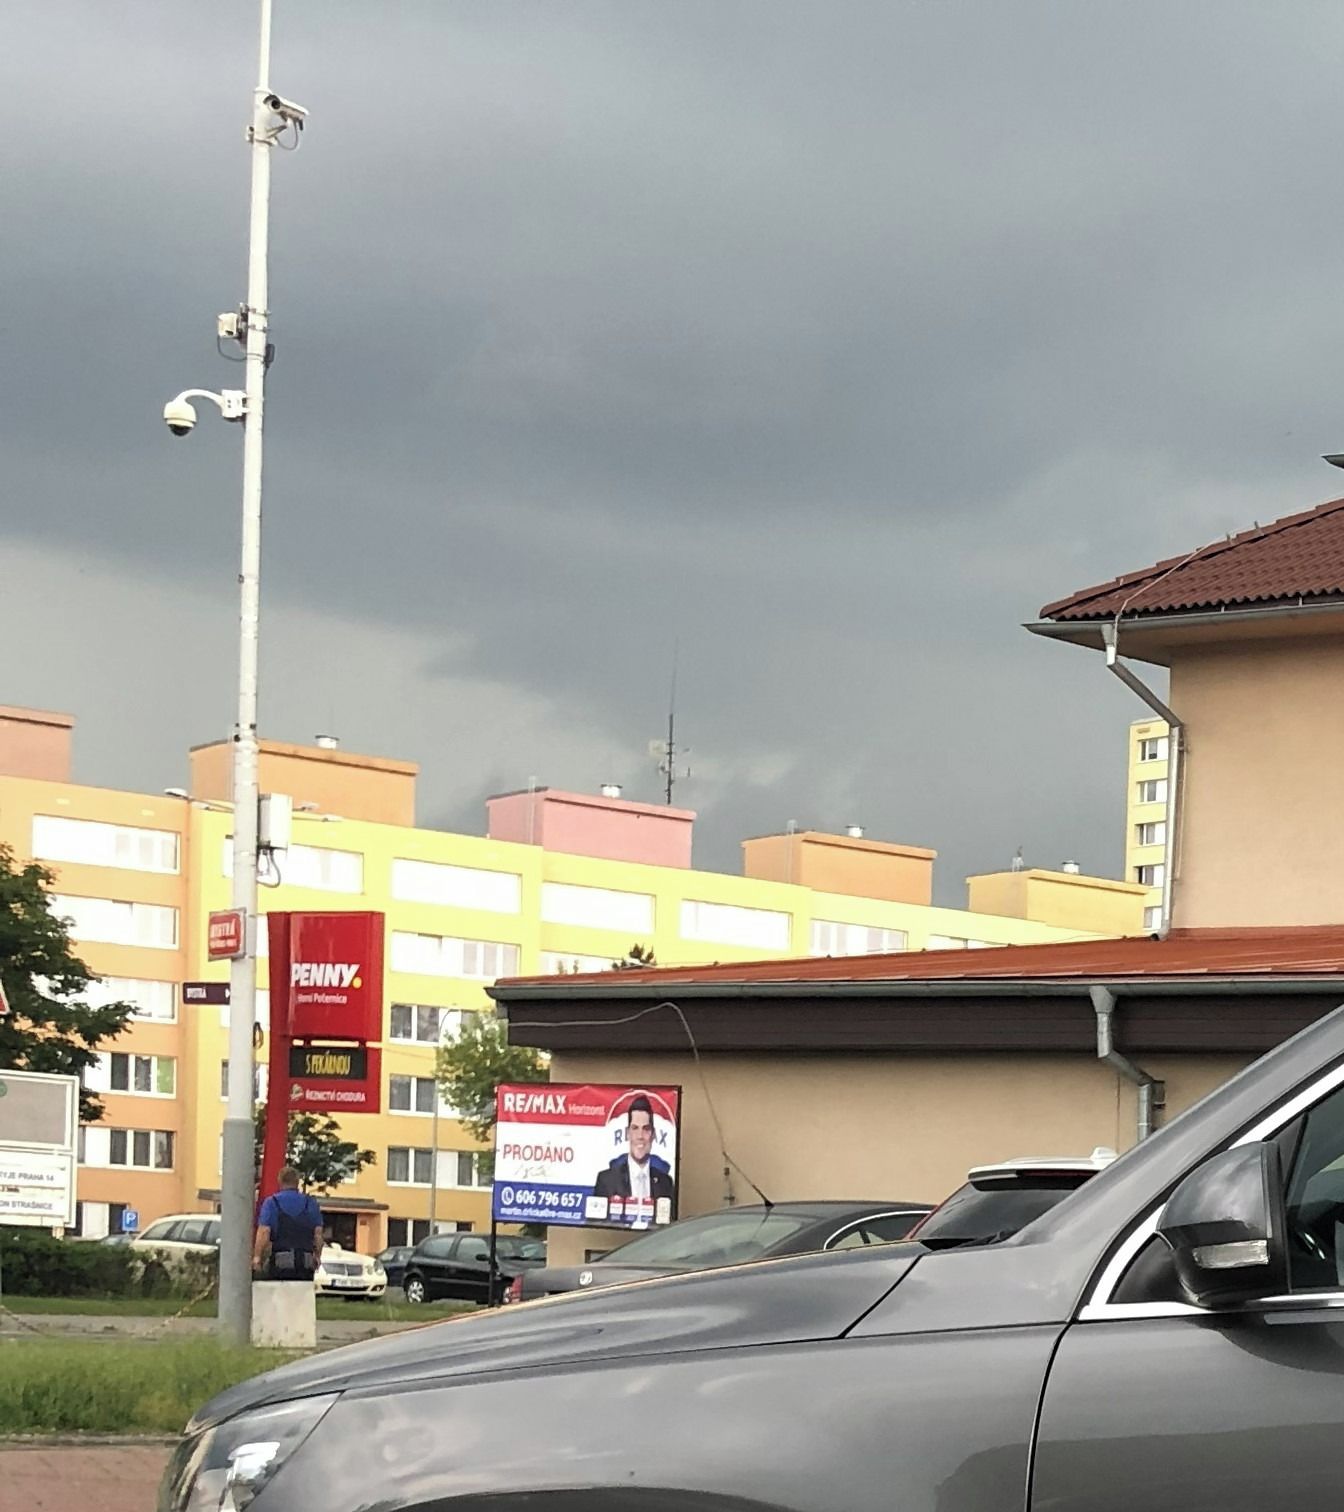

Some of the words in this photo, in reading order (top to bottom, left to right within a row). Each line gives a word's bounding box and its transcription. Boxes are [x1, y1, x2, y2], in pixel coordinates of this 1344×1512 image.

[503, 1092, 566, 1114] RE/MAX
[18, 1172, 44, 1181] PRAHA
[515, 1190, 536, 1205] 606
[538, 1191, 559, 1206] 796
[561, 1192, 583, 1208] 657
